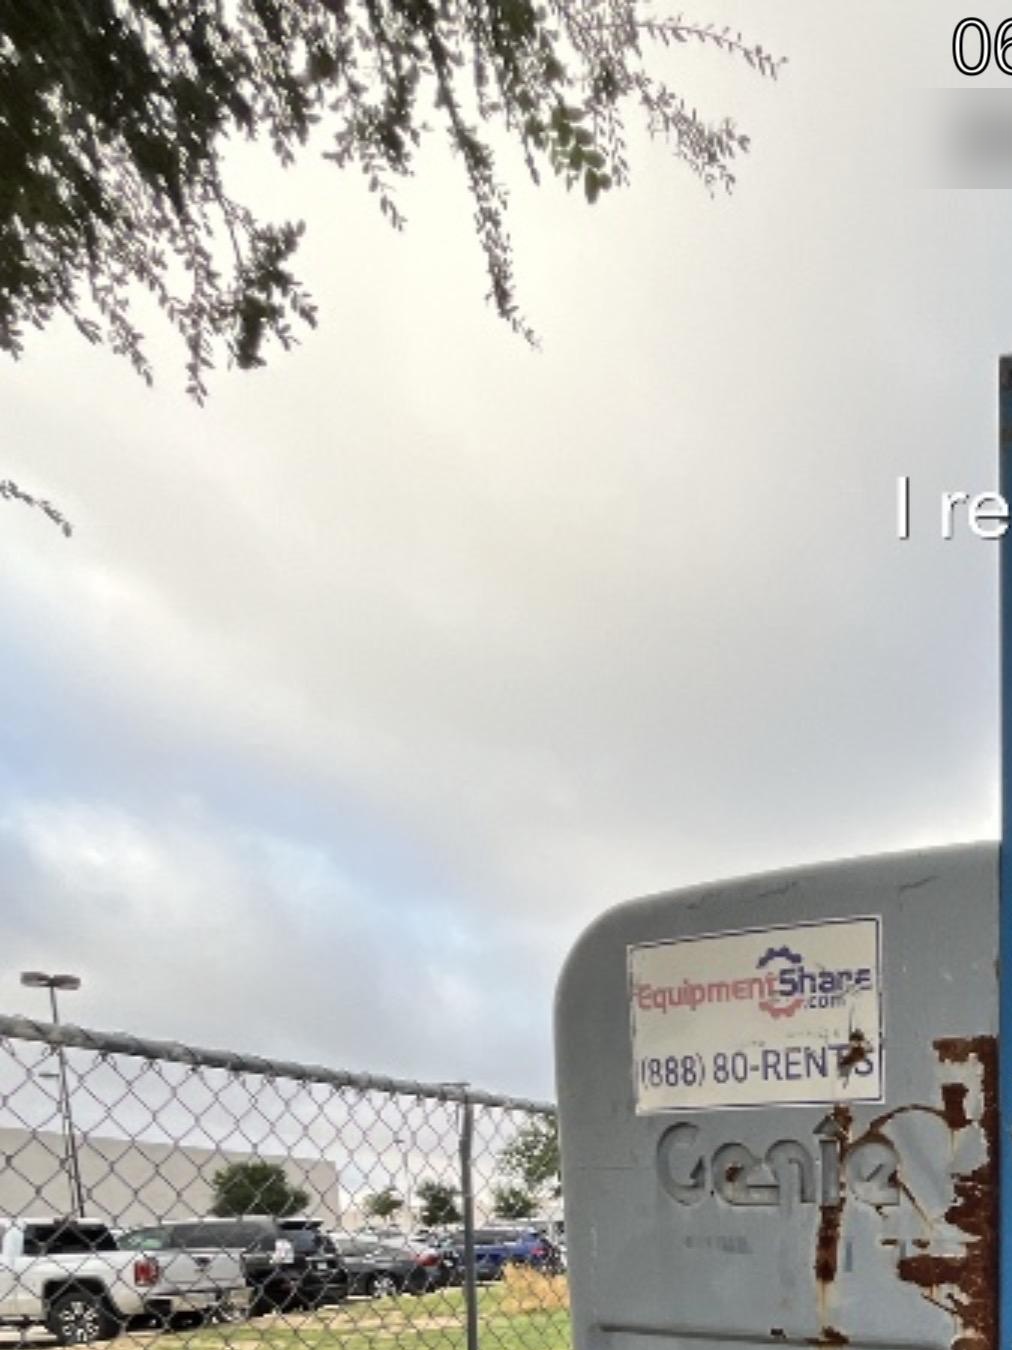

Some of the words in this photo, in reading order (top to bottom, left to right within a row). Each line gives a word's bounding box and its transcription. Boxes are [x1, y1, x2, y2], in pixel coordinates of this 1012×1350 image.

[637, 966, 871, 1013] EquipmentShare
[641, 1053, 705, 1090] (888)
[657, 1115, 901, 1206] Genie
